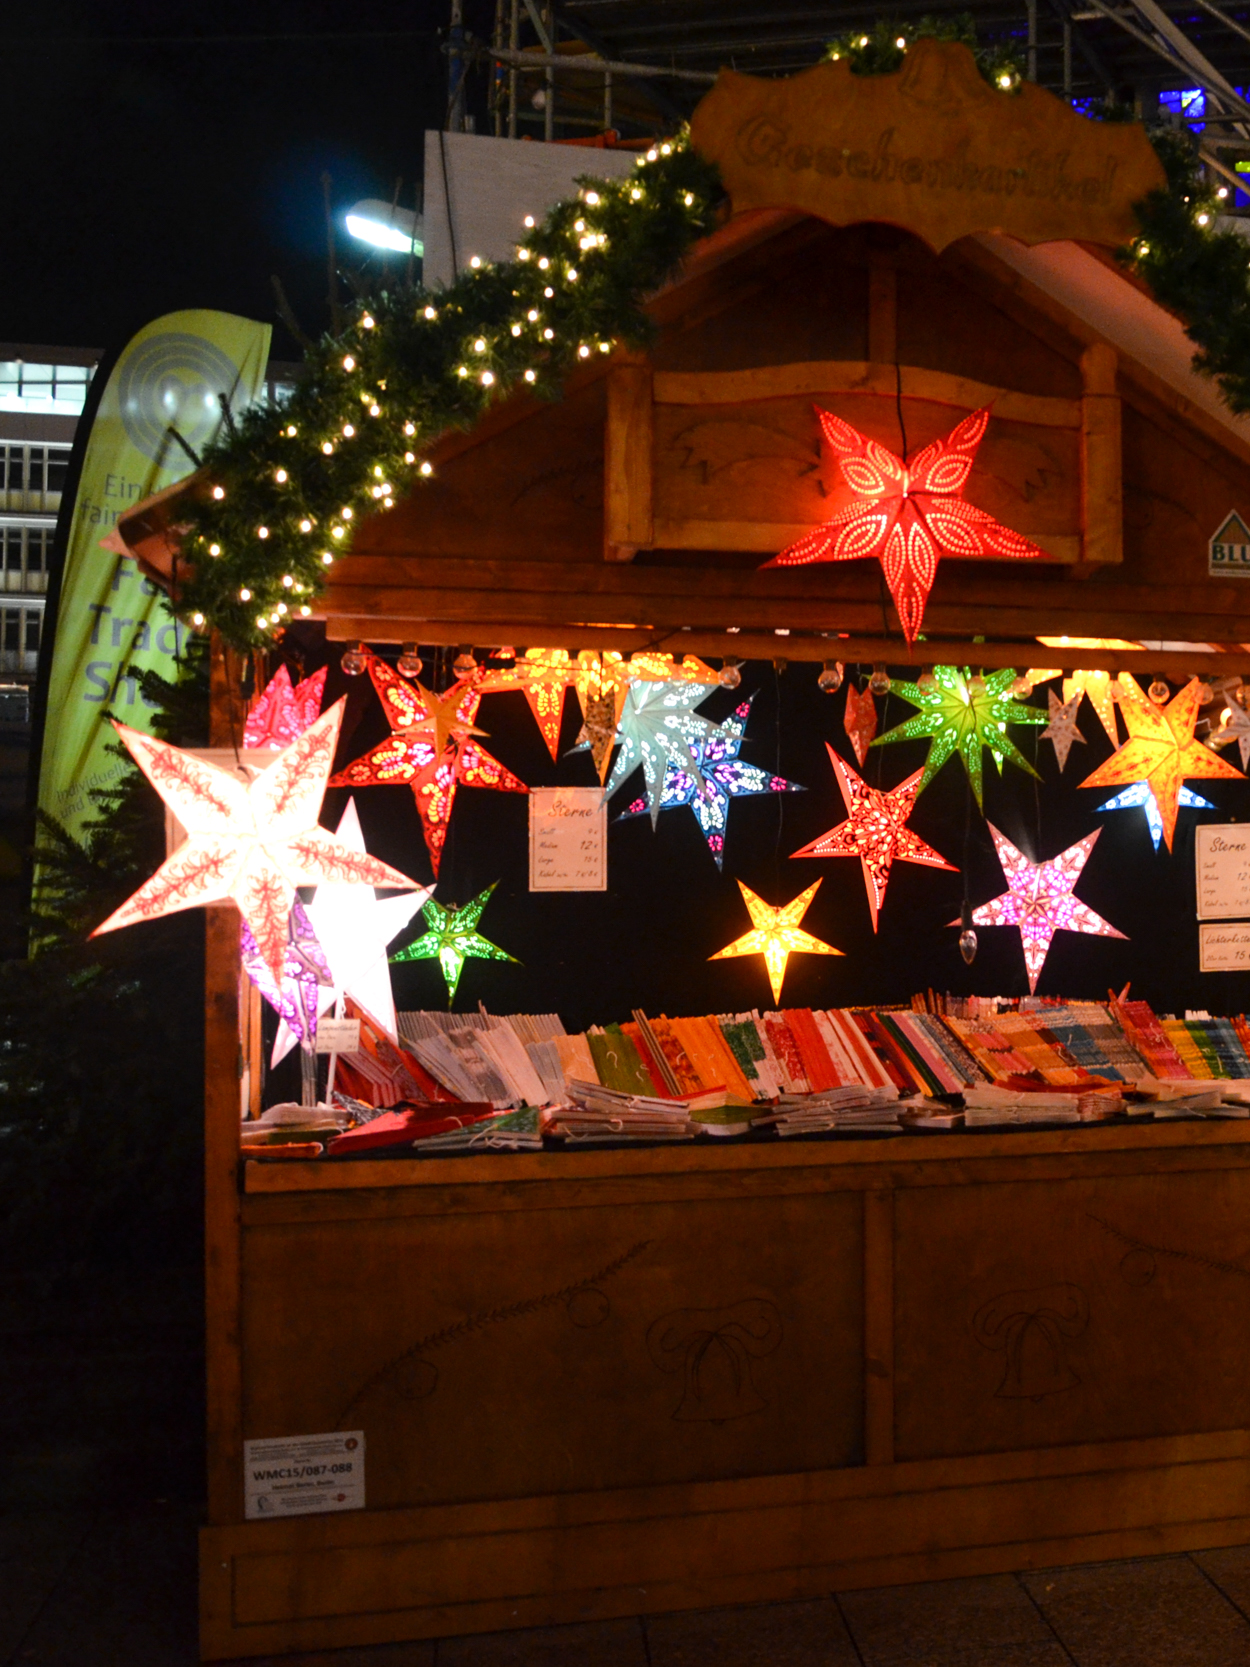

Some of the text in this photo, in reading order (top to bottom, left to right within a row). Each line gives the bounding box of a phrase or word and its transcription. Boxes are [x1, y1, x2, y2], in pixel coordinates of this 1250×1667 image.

[548, 799, 594, 817] Sterne
[1209, 837, 1247, 853] Sterne
[1235, 949, 1246, 961] 15
[252, 1461, 354, 1482] WMC15/087-088
